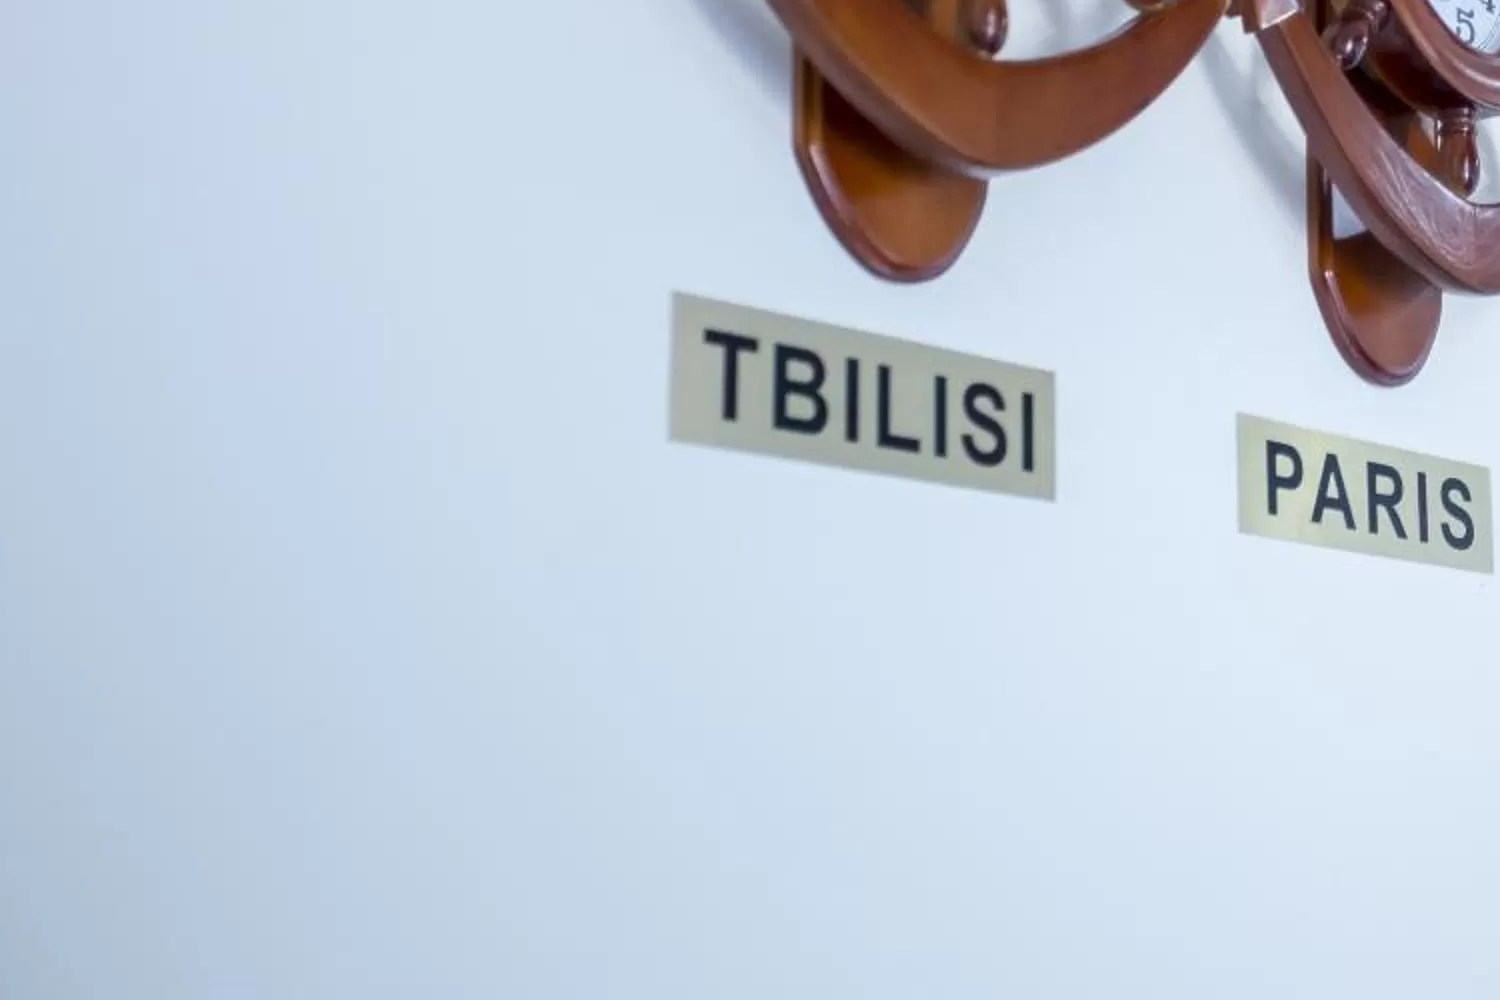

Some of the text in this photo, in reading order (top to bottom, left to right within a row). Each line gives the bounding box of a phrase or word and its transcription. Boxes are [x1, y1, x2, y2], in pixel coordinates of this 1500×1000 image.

[1456, 7, 1475, 47] 5
[703, 328, 1034, 473] TBILISI
[1265, 439, 1475, 551] PARIS
